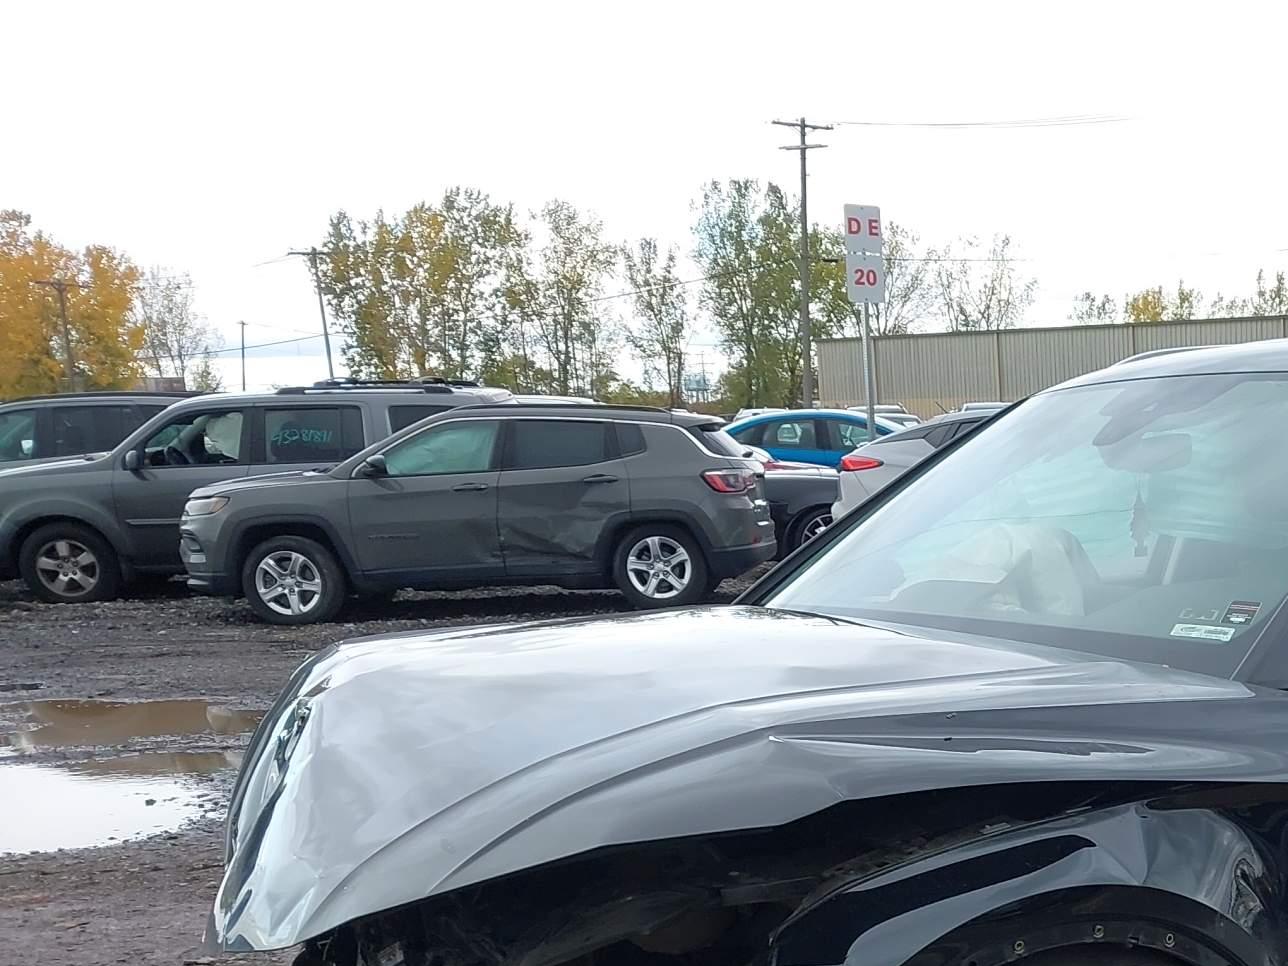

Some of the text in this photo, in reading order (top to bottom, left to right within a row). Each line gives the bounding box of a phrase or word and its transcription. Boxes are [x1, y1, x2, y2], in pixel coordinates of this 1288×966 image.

[847, 217, 880, 237] D E
[853, 268, 878, 287] 20
